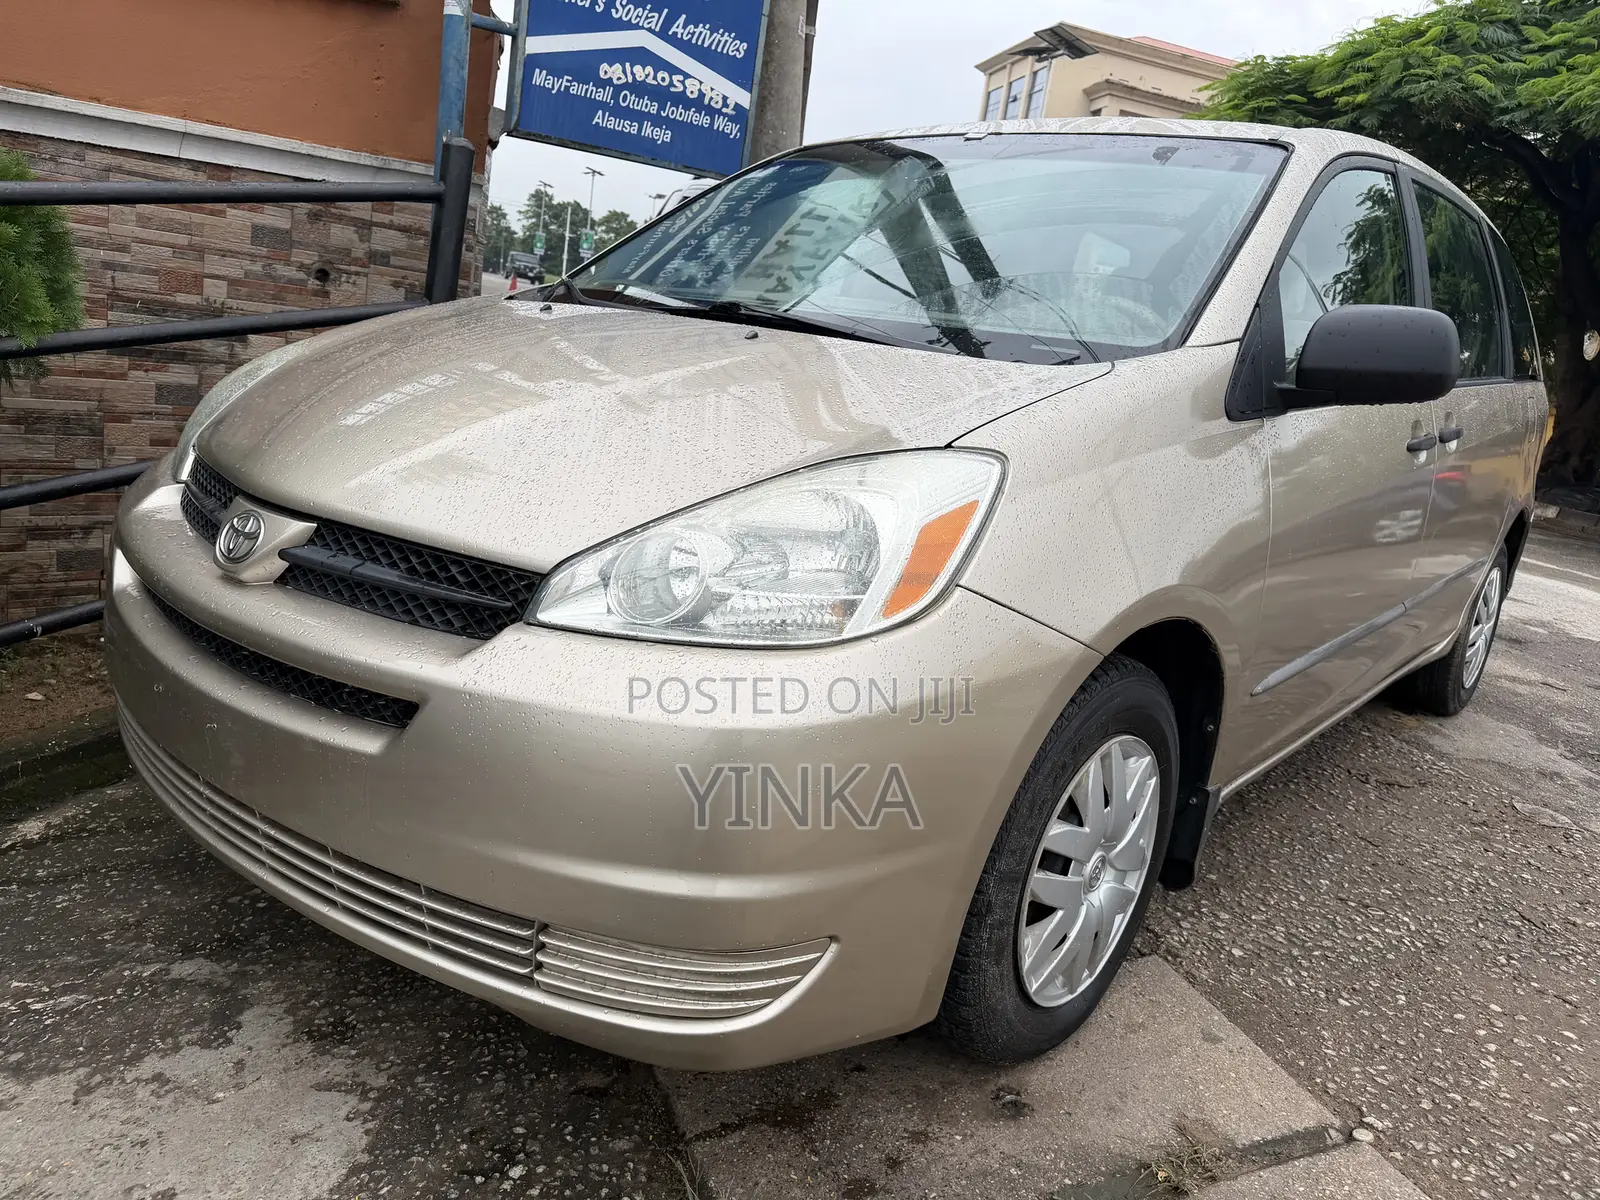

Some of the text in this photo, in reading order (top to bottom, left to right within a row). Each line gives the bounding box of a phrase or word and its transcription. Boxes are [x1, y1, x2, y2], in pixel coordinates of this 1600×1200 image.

[611, 0, 748, 59] Social Activities
[532, 68, 741, 139] MayFairhall, Otuba Jobifele Way,
[592, 109, 672, 144] Alausa Ikeja
